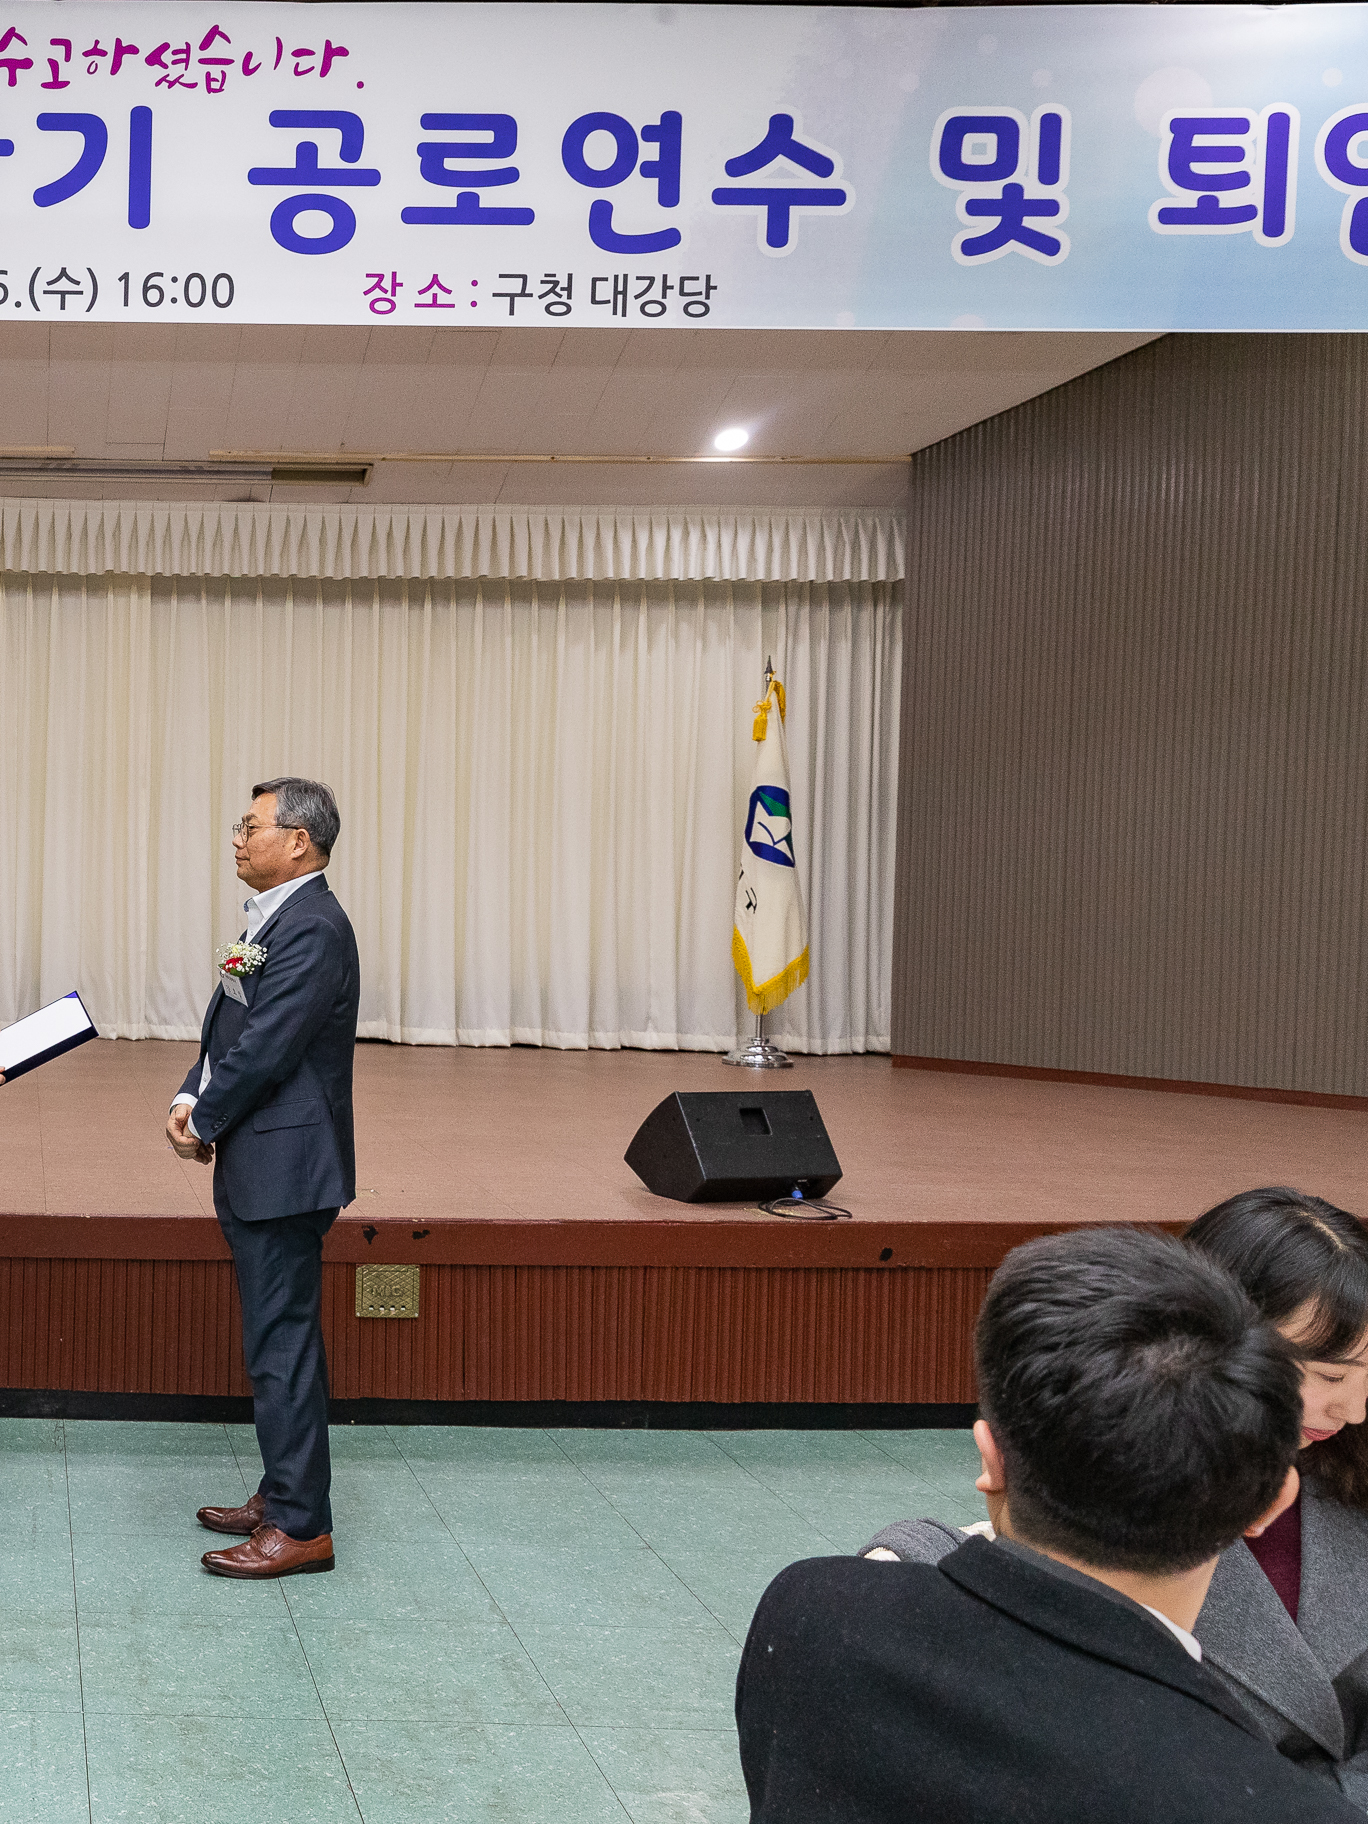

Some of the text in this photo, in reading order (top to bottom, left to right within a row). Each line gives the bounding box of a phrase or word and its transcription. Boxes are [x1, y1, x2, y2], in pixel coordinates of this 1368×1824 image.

[247, 109, 847, 255] 공로연수
[939, 112, 1062, 257] 및
[117, 271, 235, 309] 16:00
[492, 272, 573, 317] 구청
[590, 273, 718, 318] 대강당
